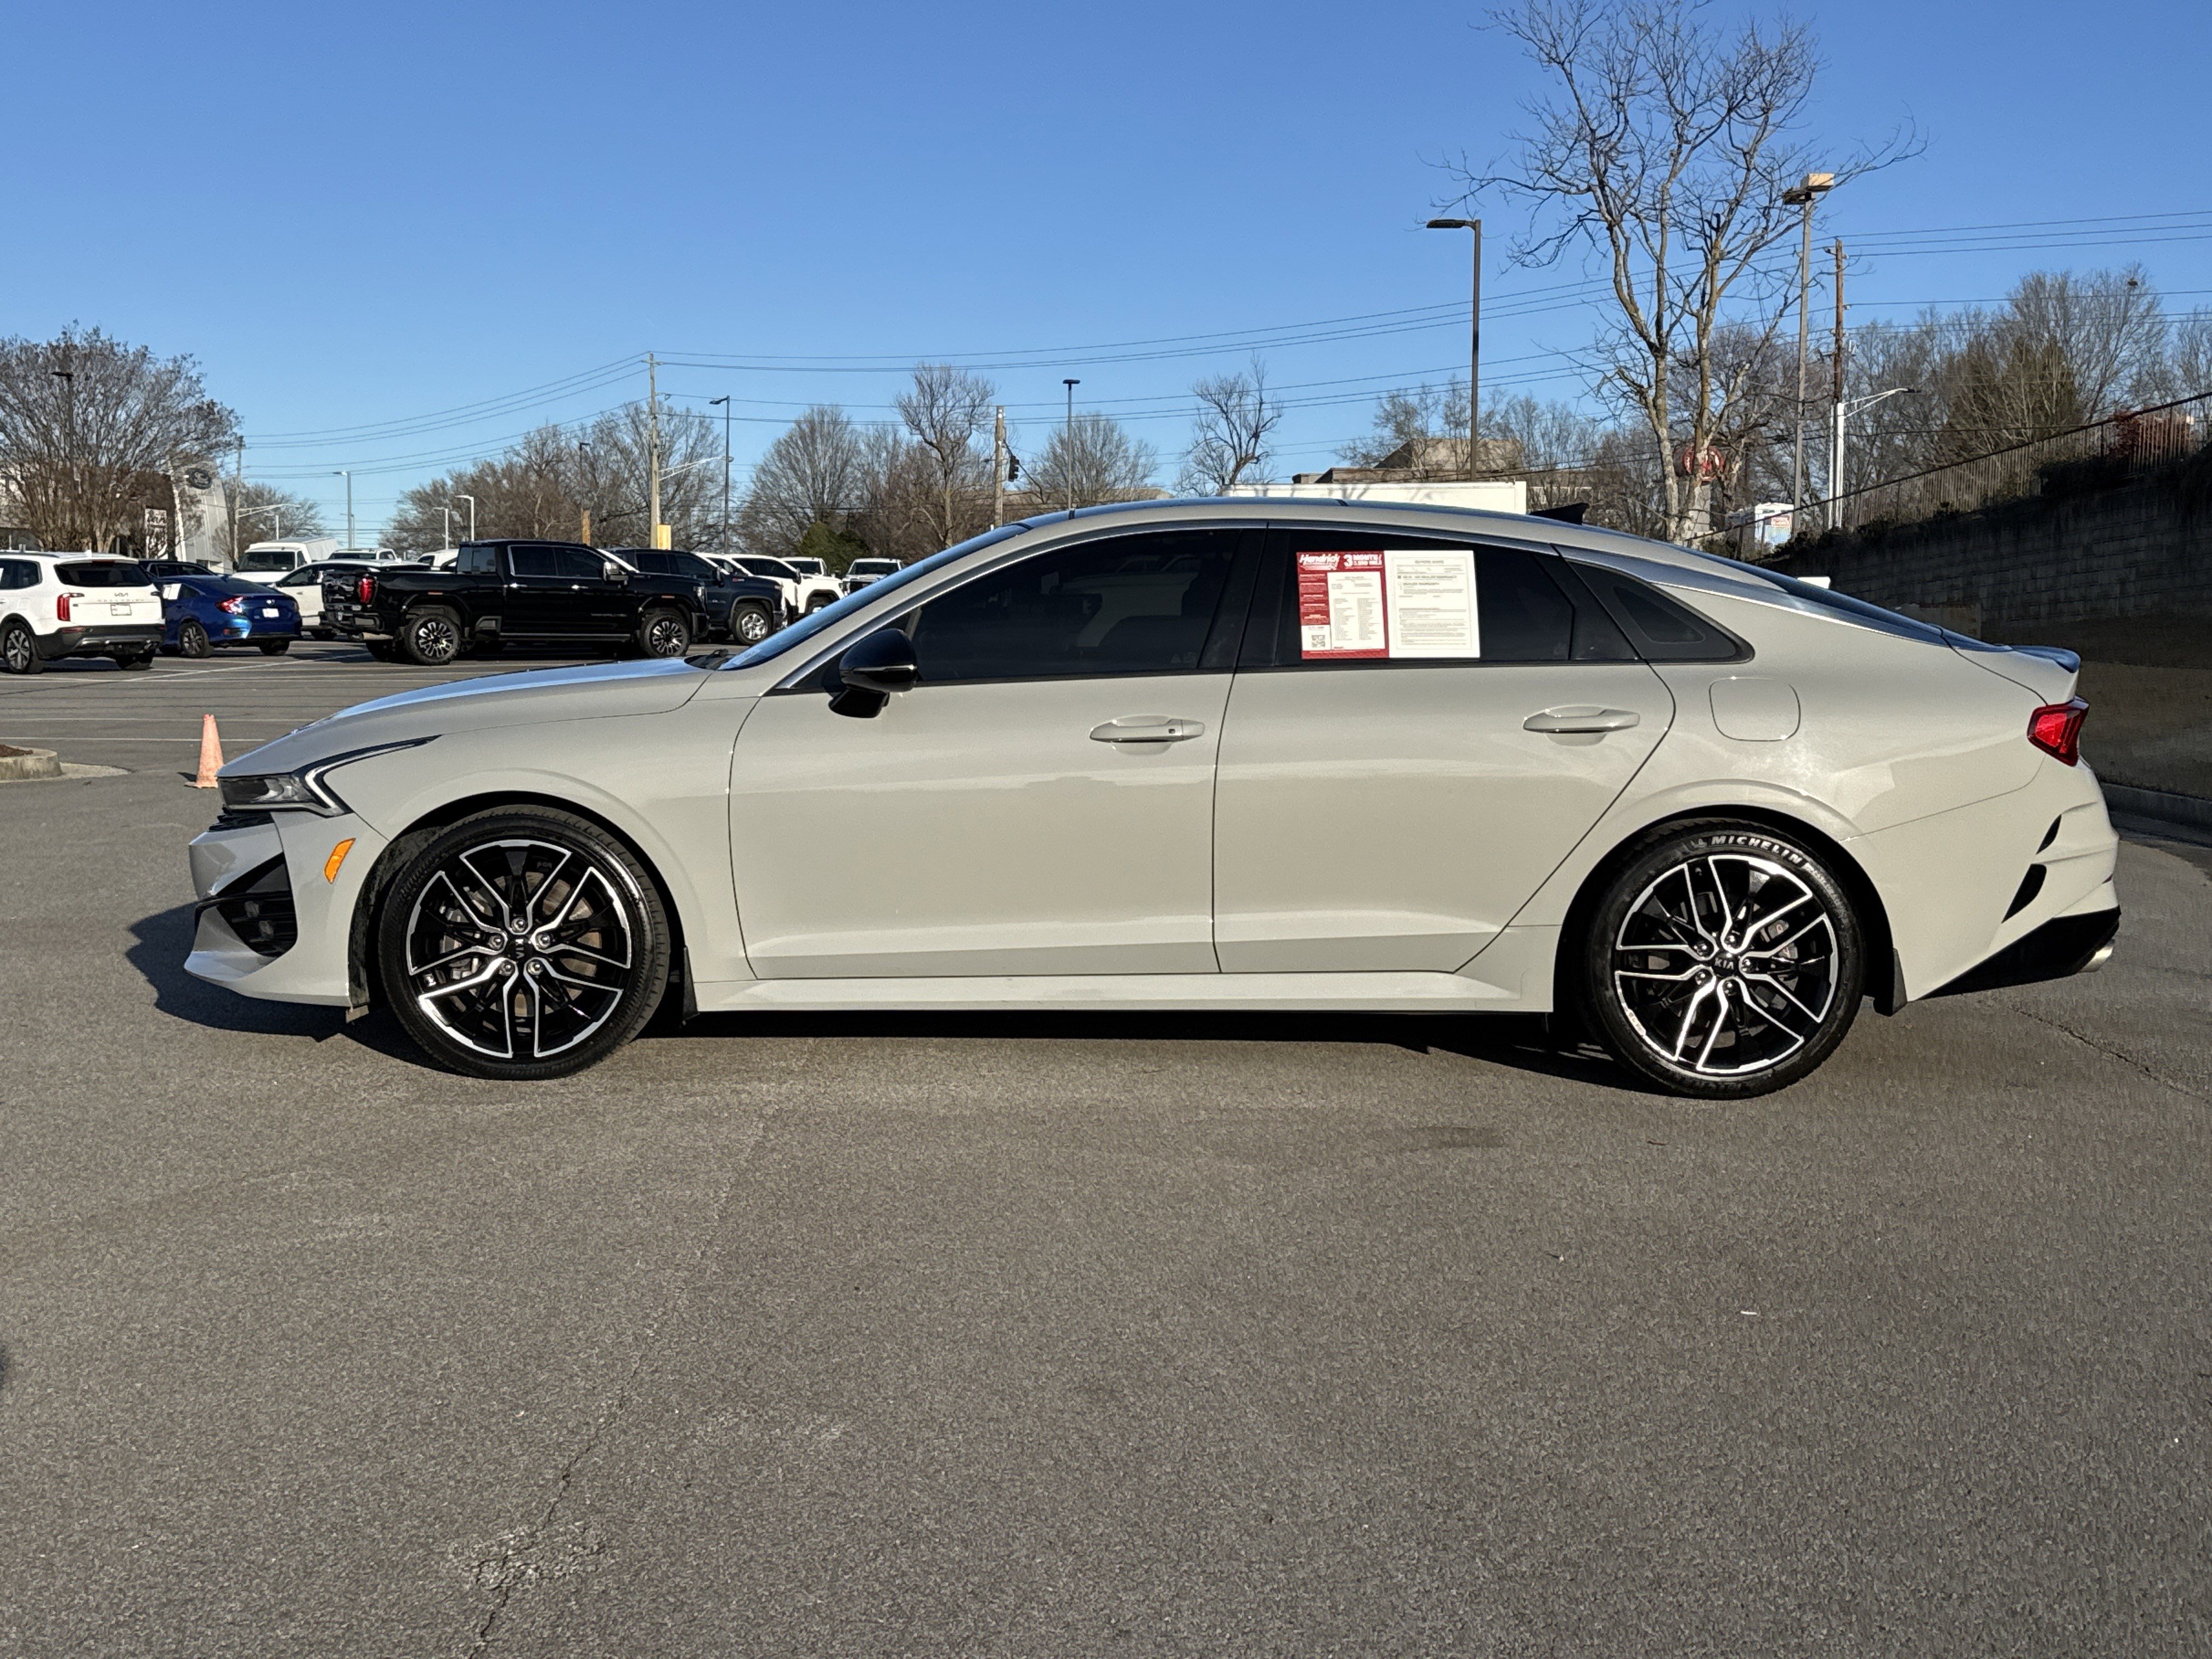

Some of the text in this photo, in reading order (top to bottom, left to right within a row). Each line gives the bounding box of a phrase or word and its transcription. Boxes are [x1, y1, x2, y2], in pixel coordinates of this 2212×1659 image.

[1344, 554, 1353, 567] 3
[1711, 836, 1803, 865] MICHELIN
[516, 939, 524, 959] KIA
[1714, 957, 1734, 970] KIA
